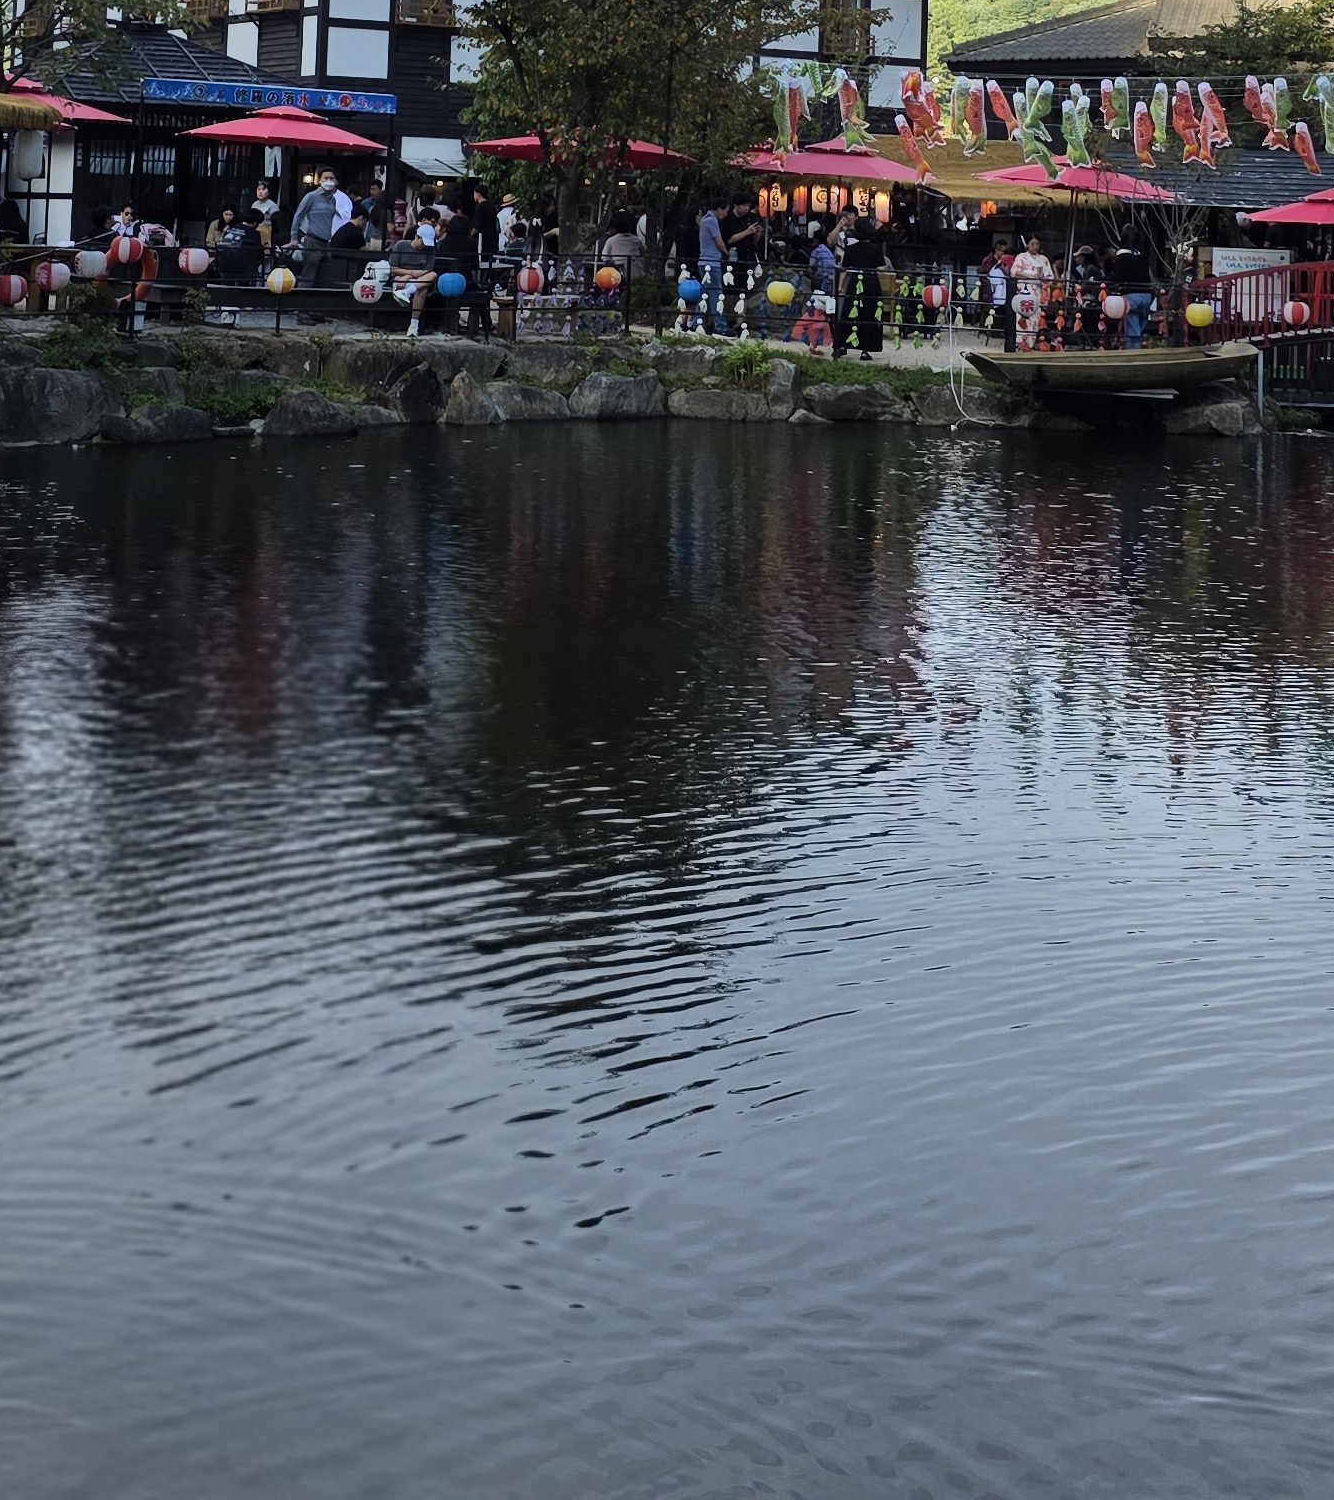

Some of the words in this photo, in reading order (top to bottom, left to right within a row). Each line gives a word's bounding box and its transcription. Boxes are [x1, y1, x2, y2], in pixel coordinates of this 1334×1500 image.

[233, 88, 310, 107] 修羅の落水
[360, 284, 376, 299] 祭
[1019, 298, 1034, 313] 祭
